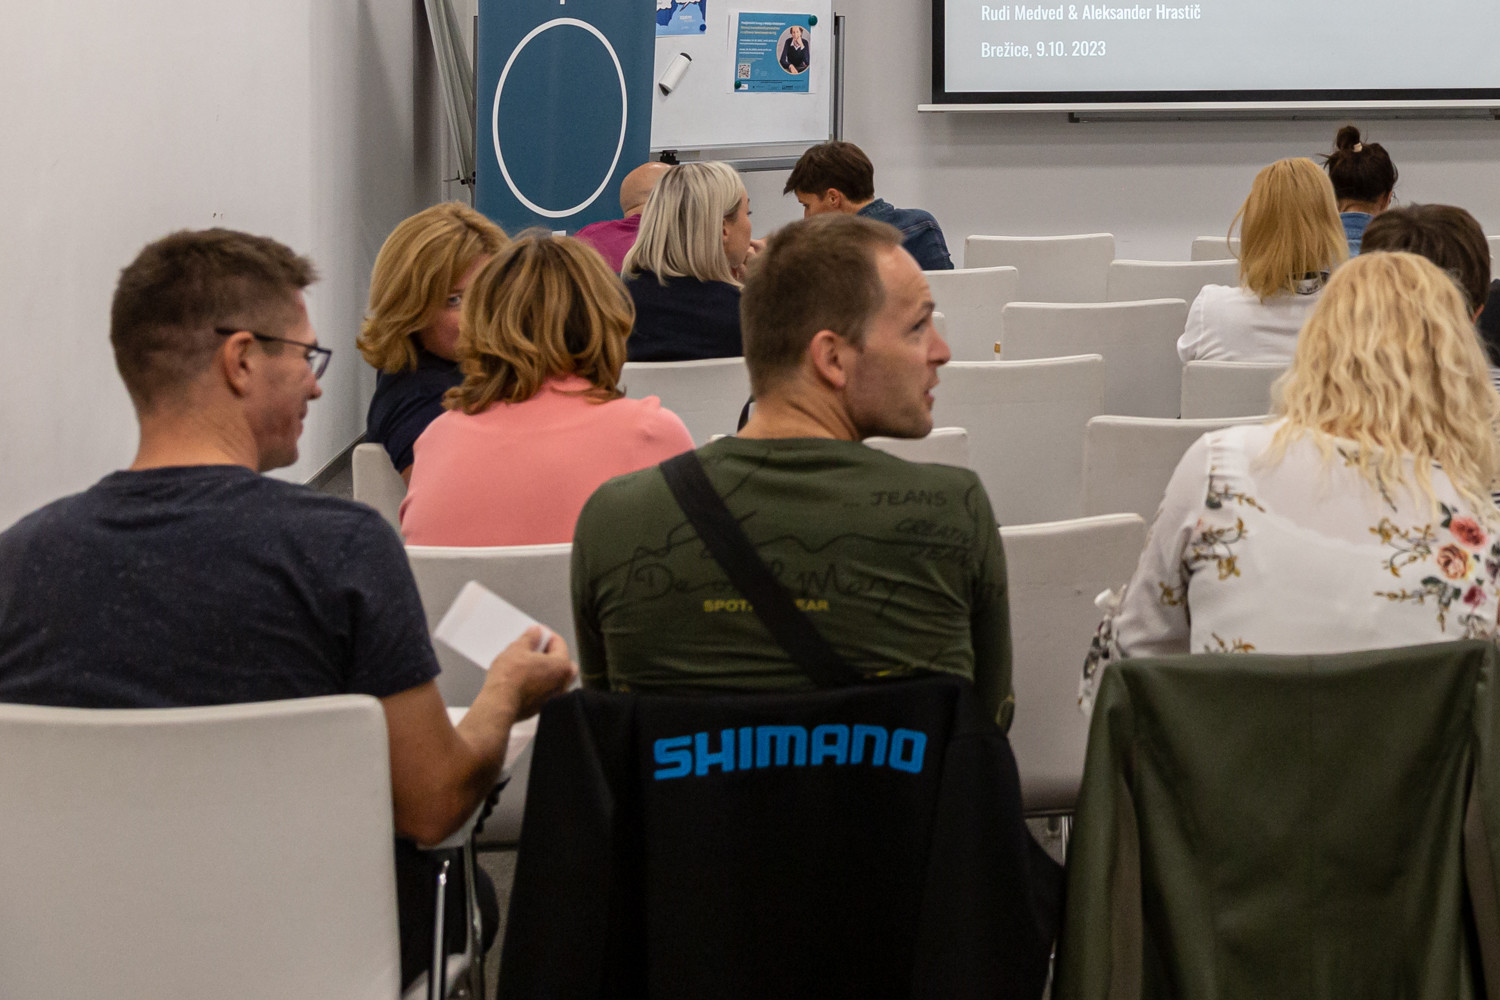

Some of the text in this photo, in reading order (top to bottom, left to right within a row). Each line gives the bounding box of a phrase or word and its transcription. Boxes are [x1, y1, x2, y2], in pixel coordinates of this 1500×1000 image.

[981, 3, 1201, 21] Rudi Medved & Aleksander Hrastič
[981, 41, 1106, 59] Brežice, 9.10. 2023
[870, 489, 947, 507] JEANS
[653, 723, 928, 781] SHIMANO
